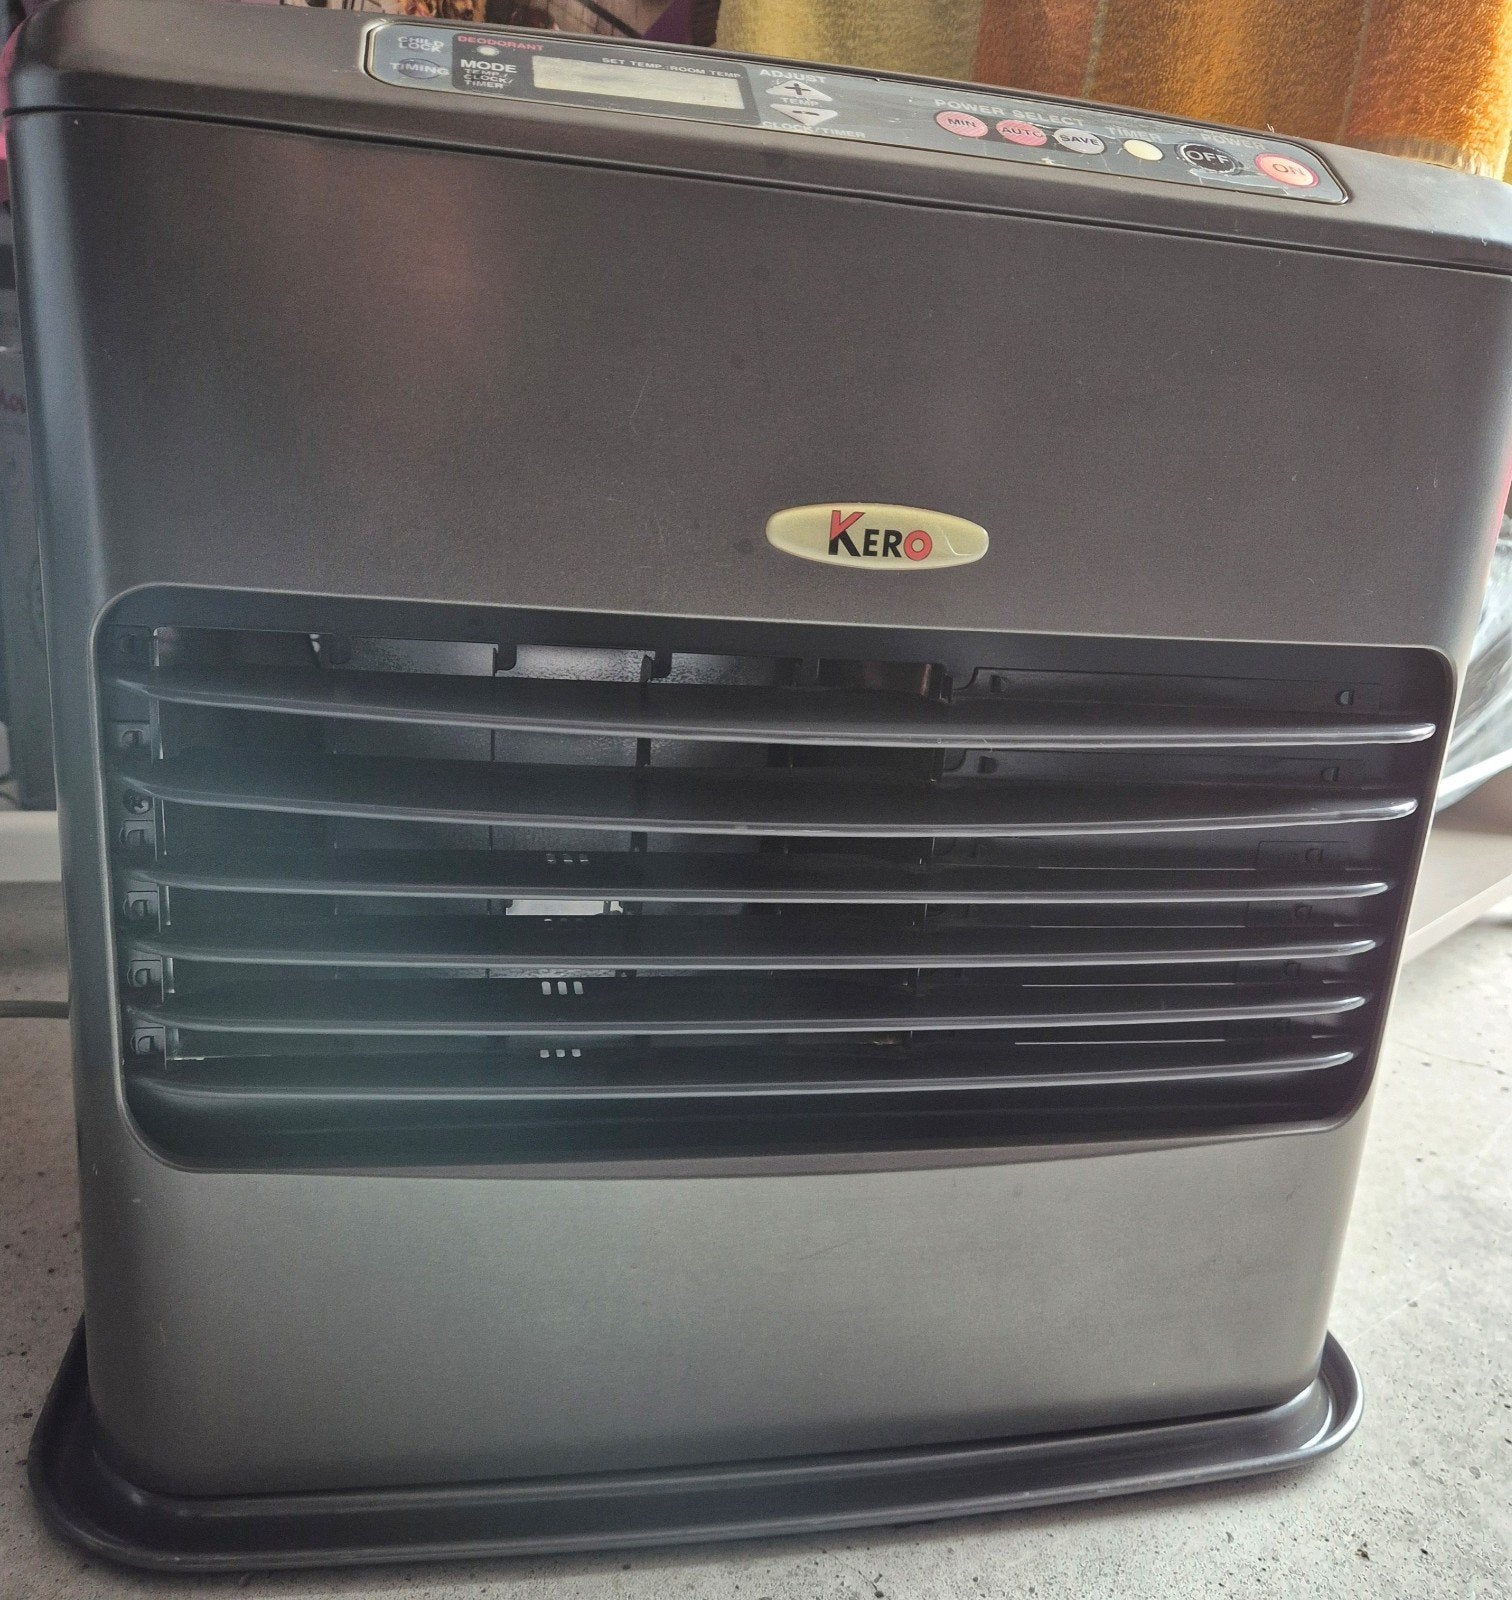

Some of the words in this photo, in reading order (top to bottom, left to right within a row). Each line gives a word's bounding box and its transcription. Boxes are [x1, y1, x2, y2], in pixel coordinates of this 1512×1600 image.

[397, 36, 445, 48] CHILD
[399, 43, 442, 53] LOCK
[457, 36, 544, 51] DEODORANT
[389, 62, 450, 76] TIMING
[460, 58, 518, 74] MODE
[601, 57, 625, 65] SET
[669, 65, 706, 75] ROOM
[759, 68, 828, 85] ADJUST
[464, 79, 504, 89] TIMER
[934, 99, 1006, 116] POWER
[1013, 109, 1085, 127] SELECT
[947, 117, 976, 128] MIN
[1001, 126, 1043, 138] AUTO
[1107, 126, 1162, 143] TIMER
[1059, 134, 1099, 146] SAVE
[1200, 133, 1267, 150] POWER
[1187, 149, 1230, 165] OFF
[1272, 163, 1304, 175] ON
